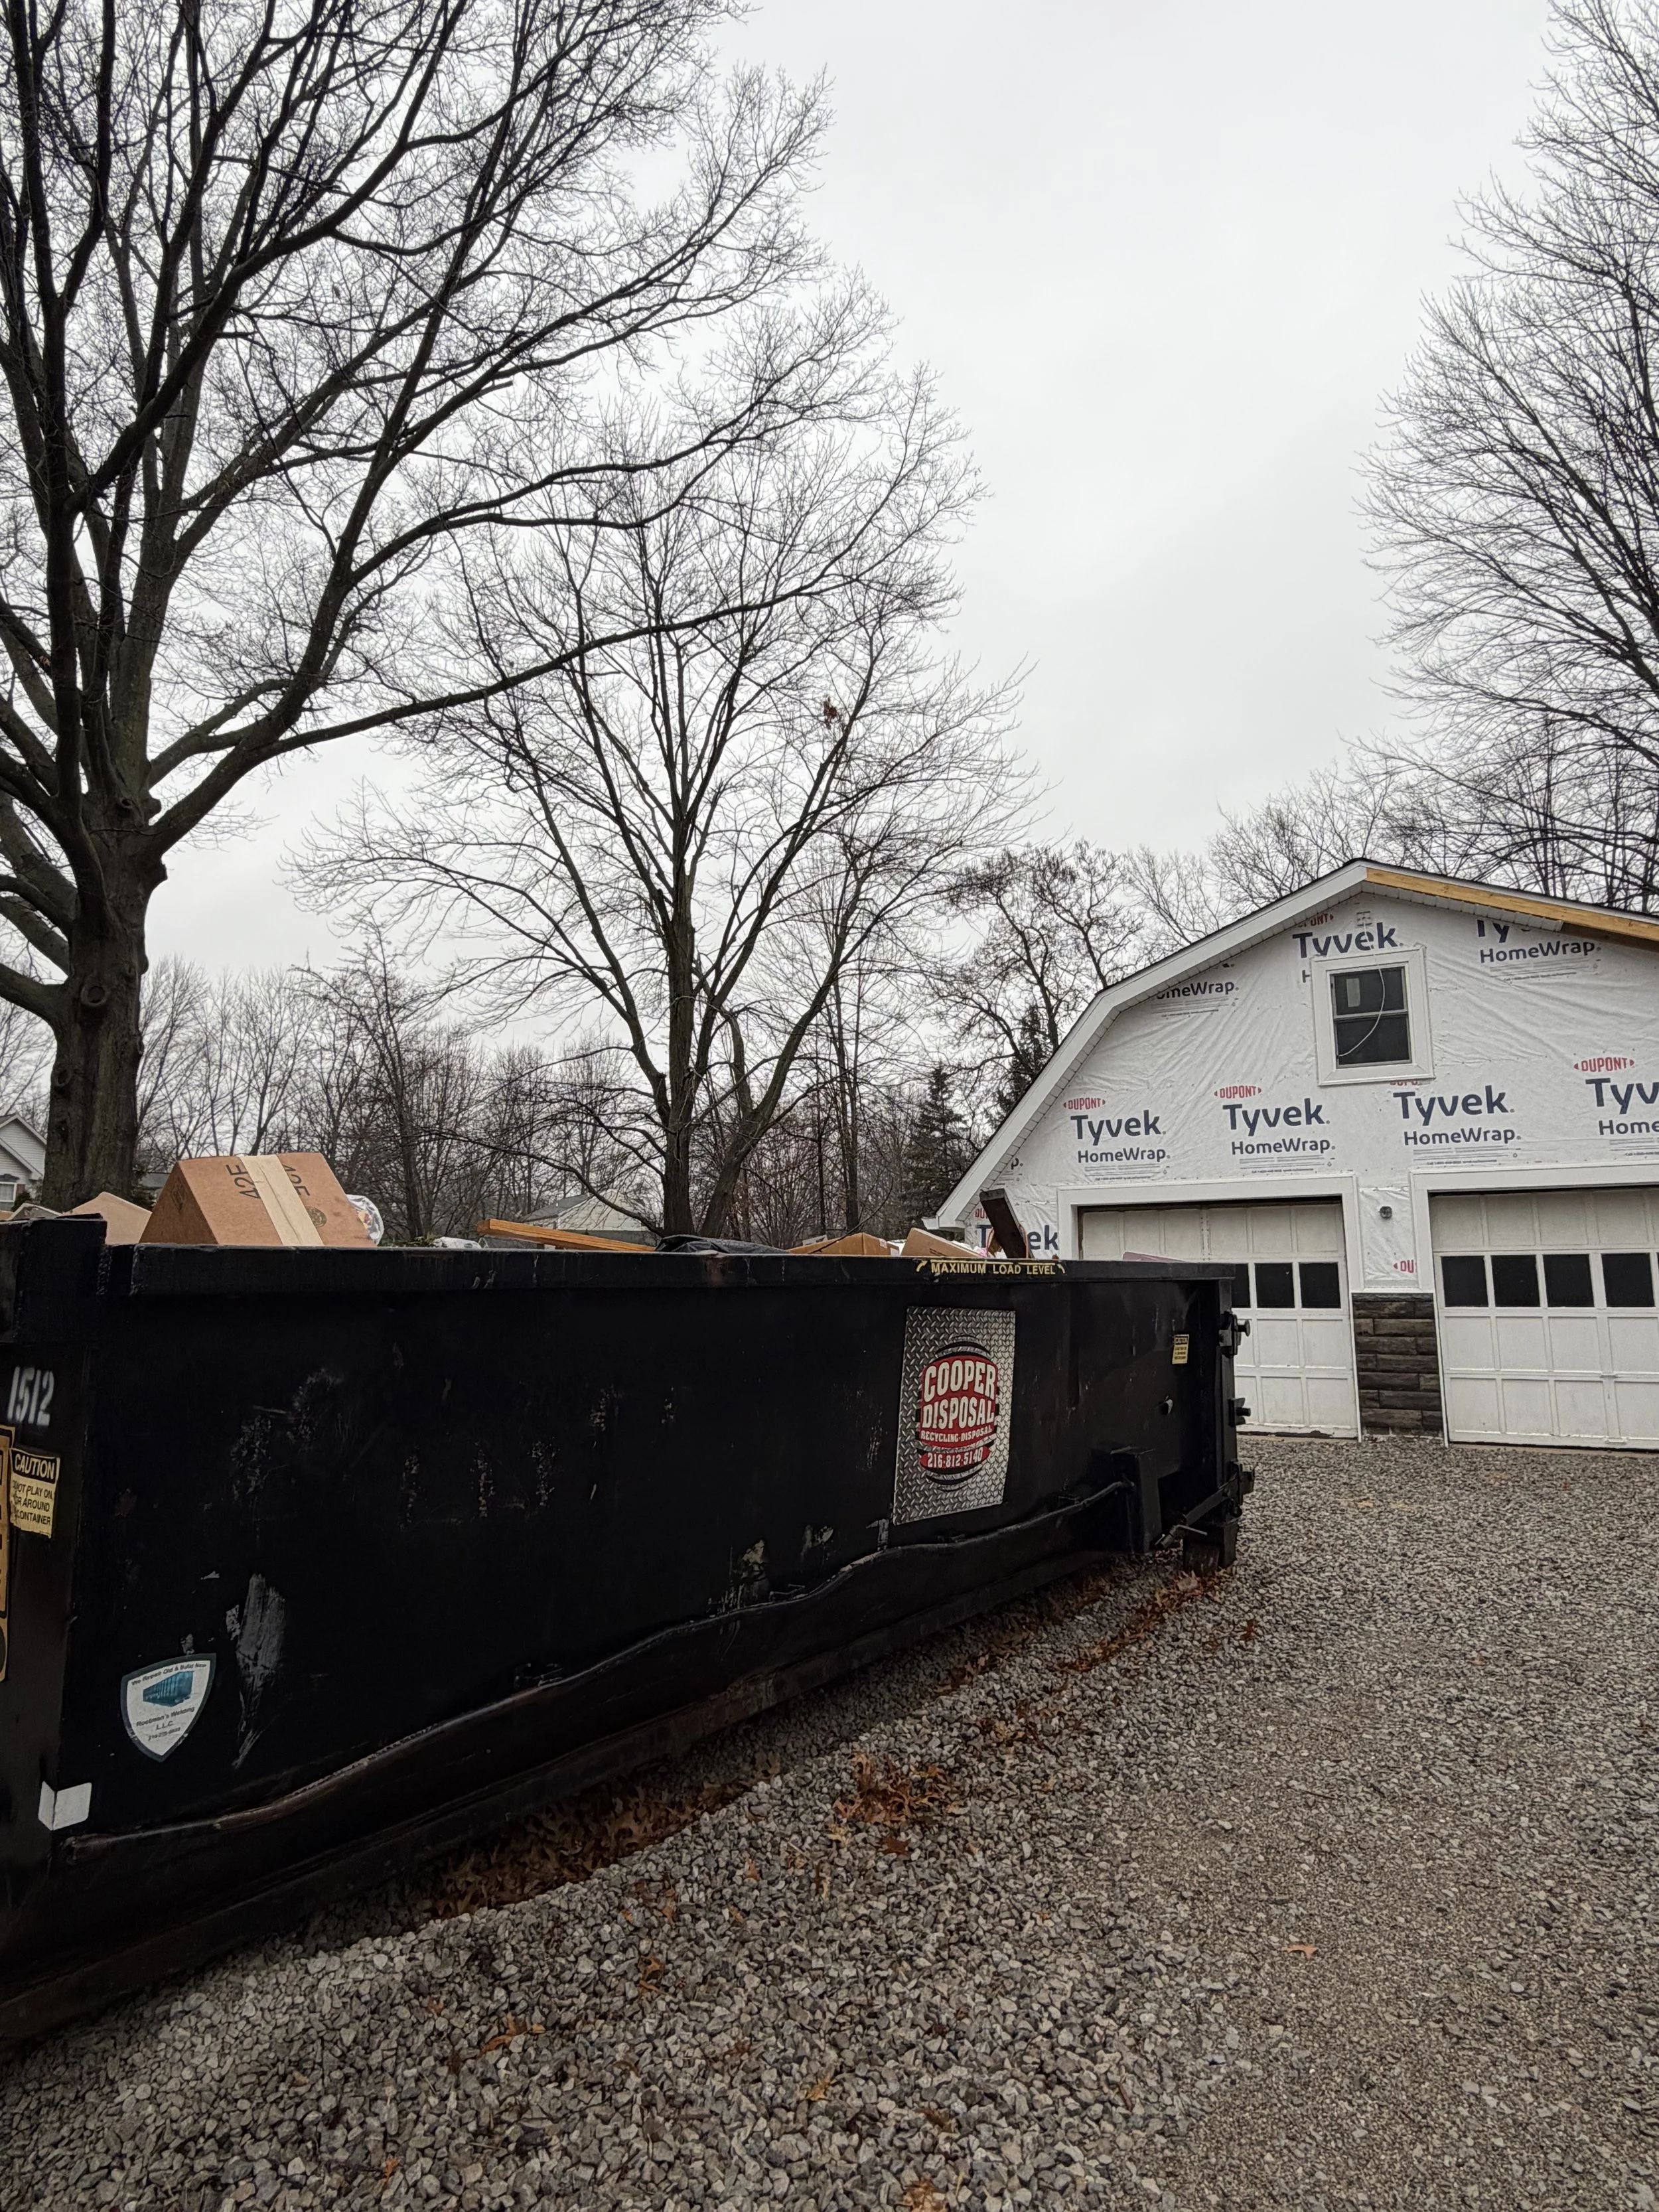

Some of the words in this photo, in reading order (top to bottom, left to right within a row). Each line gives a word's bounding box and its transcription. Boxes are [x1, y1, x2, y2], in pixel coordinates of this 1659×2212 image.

[1480, 941, 1595, 964] HomeWrap
[1157, 982, 1235, 999] meWrap
[1581, 1057, 1628, 1072] DUPONT
[1220, 1085, 1256, 1098] DUPONT
[1068, 1098, 1102, 1110] DUPONT
[1393, 1085, 1509, 1126] Tyvek
[1222, 1098, 1325, 1136] Tyvek
[1070, 1110, 1161, 1145] Tyvek
[1404, 1127, 1515, 1145] HomeWrap
[1078, 1147, 1165, 1163] HomeWrap
[1232, 1138, 1331, 1155] HomeWrap
[930, 1263, 986, 1274] MAXIMUM
[993, 1264, 1021, 1274] LOAD
[1027, 1265, 1056, 1274] LEVEL
[924, 1360, 995, 1402] COOPER
[7, 1366, 54, 1426] 1512
[922, 1396, 994, 1429] DISPOSAL
[15, 1453, 55, 1479] CAUTION
[27, 1485, 42, 1497] PLAY
[23, 1498, 50, 1512] AROUND
